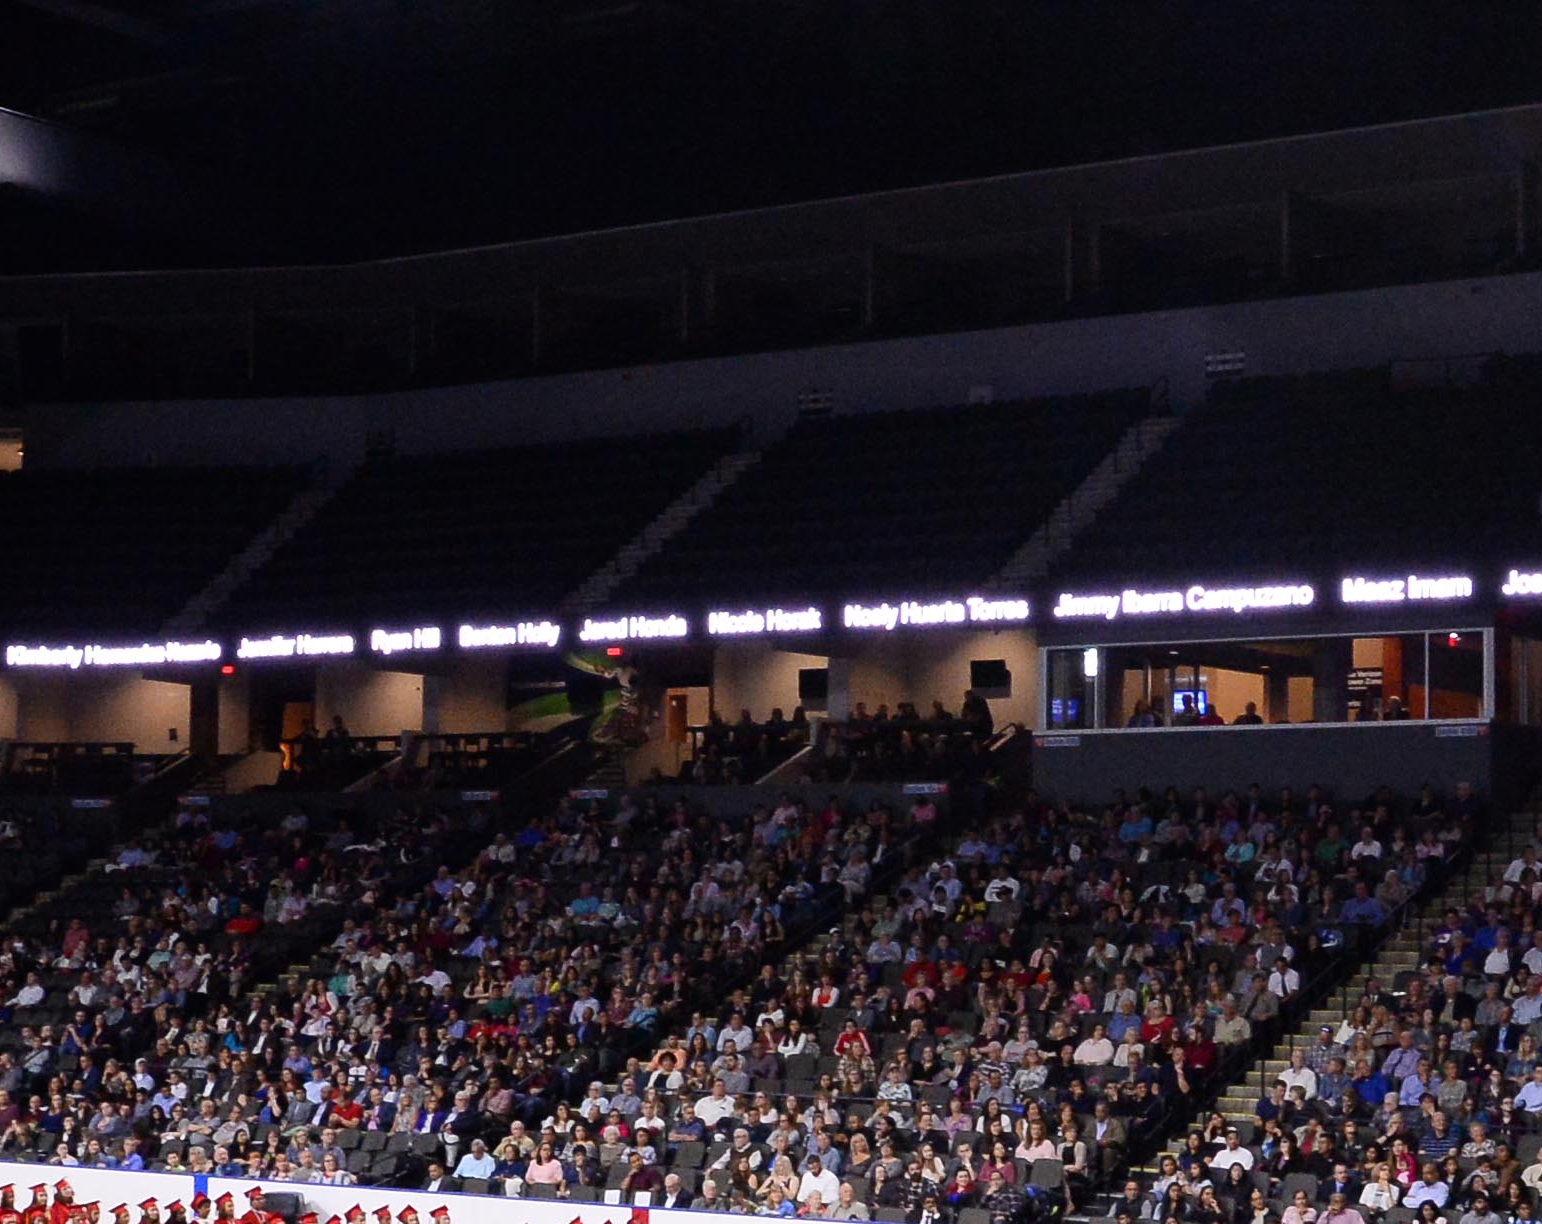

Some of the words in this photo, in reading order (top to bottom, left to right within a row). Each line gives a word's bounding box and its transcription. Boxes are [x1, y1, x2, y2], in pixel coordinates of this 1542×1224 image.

[966, 596, 1030, 622] Torres
[1053, 593, 1121, 620] Jimmy
[1121, 589, 1185, 614] Ibarra
[1185, 584, 1315, 613] Campuzano
